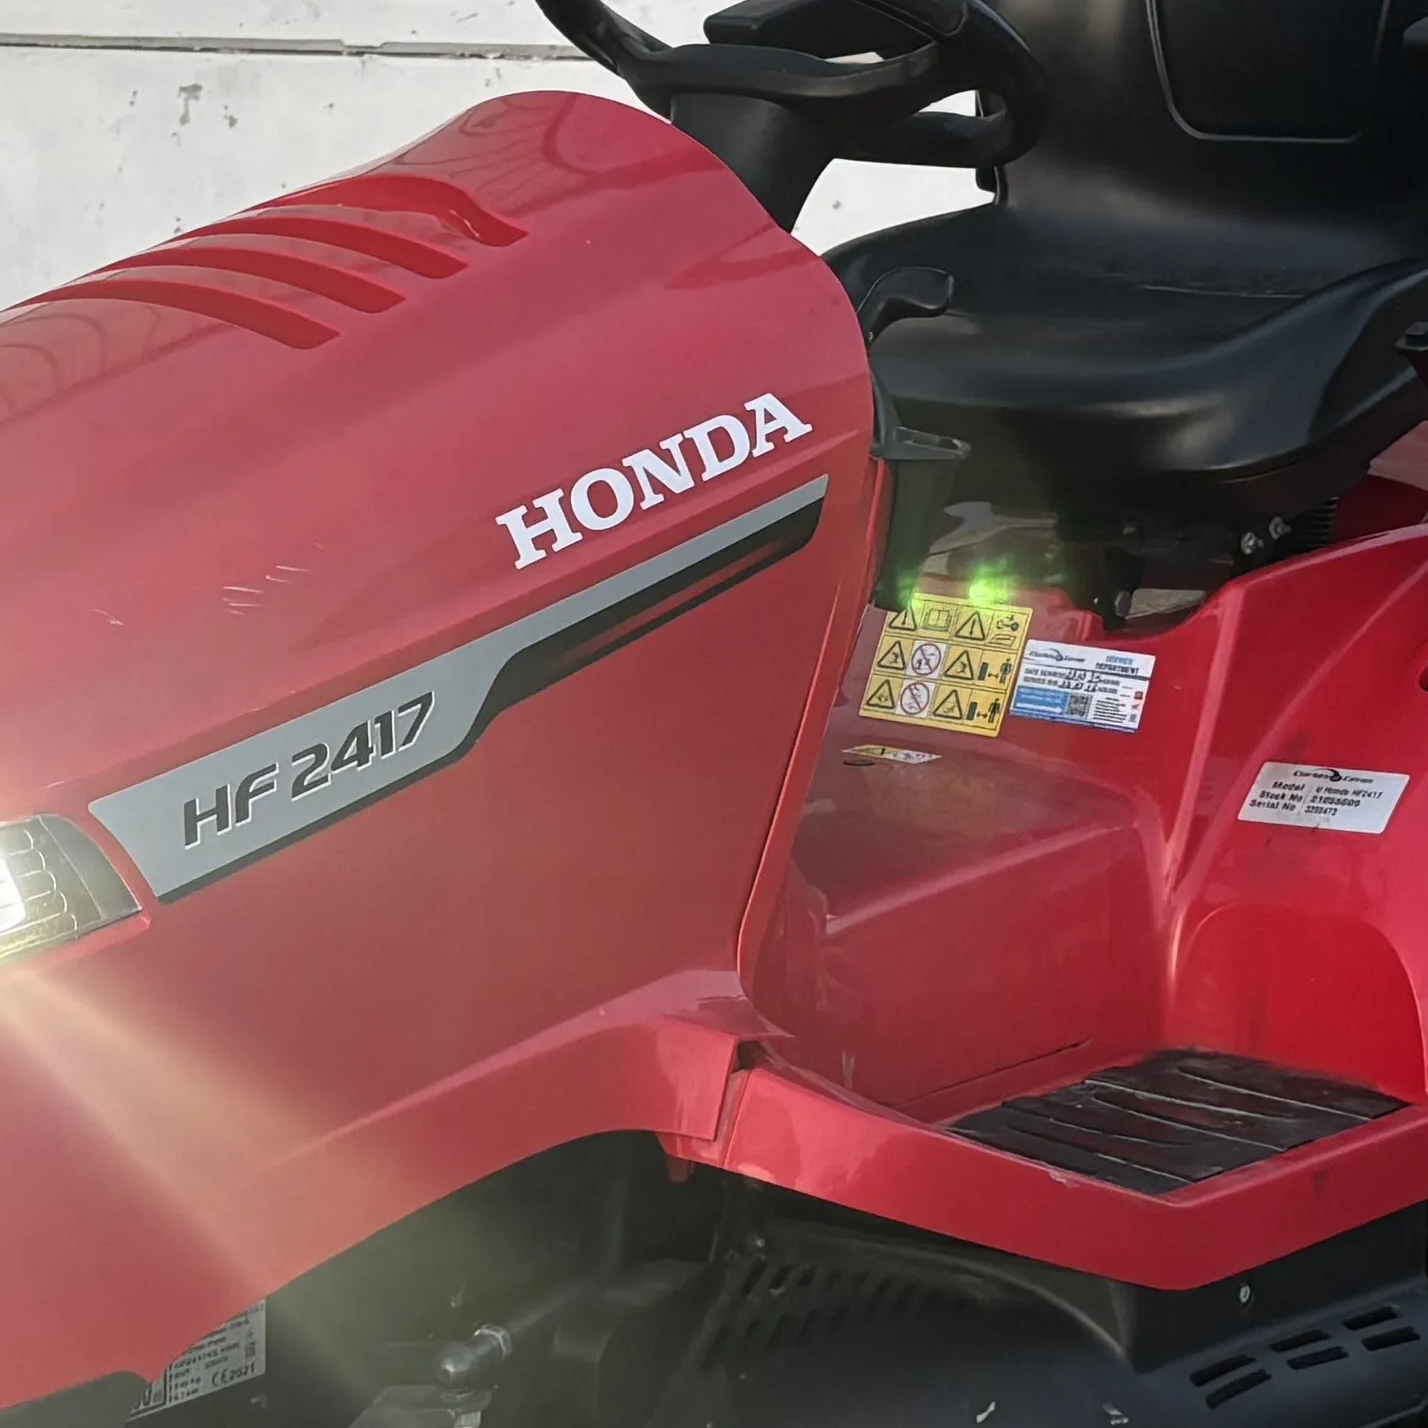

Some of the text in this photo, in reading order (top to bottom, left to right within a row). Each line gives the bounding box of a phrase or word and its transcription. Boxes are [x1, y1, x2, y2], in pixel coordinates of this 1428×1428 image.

[495, 392, 813, 570] HONDA
[183, 690, 435, 850] HF 2417
[1272, 781, 1305, 791] Model
[1259, 790, 1285, 800] Stock
[1249, 799, 1280, 809] Serial
